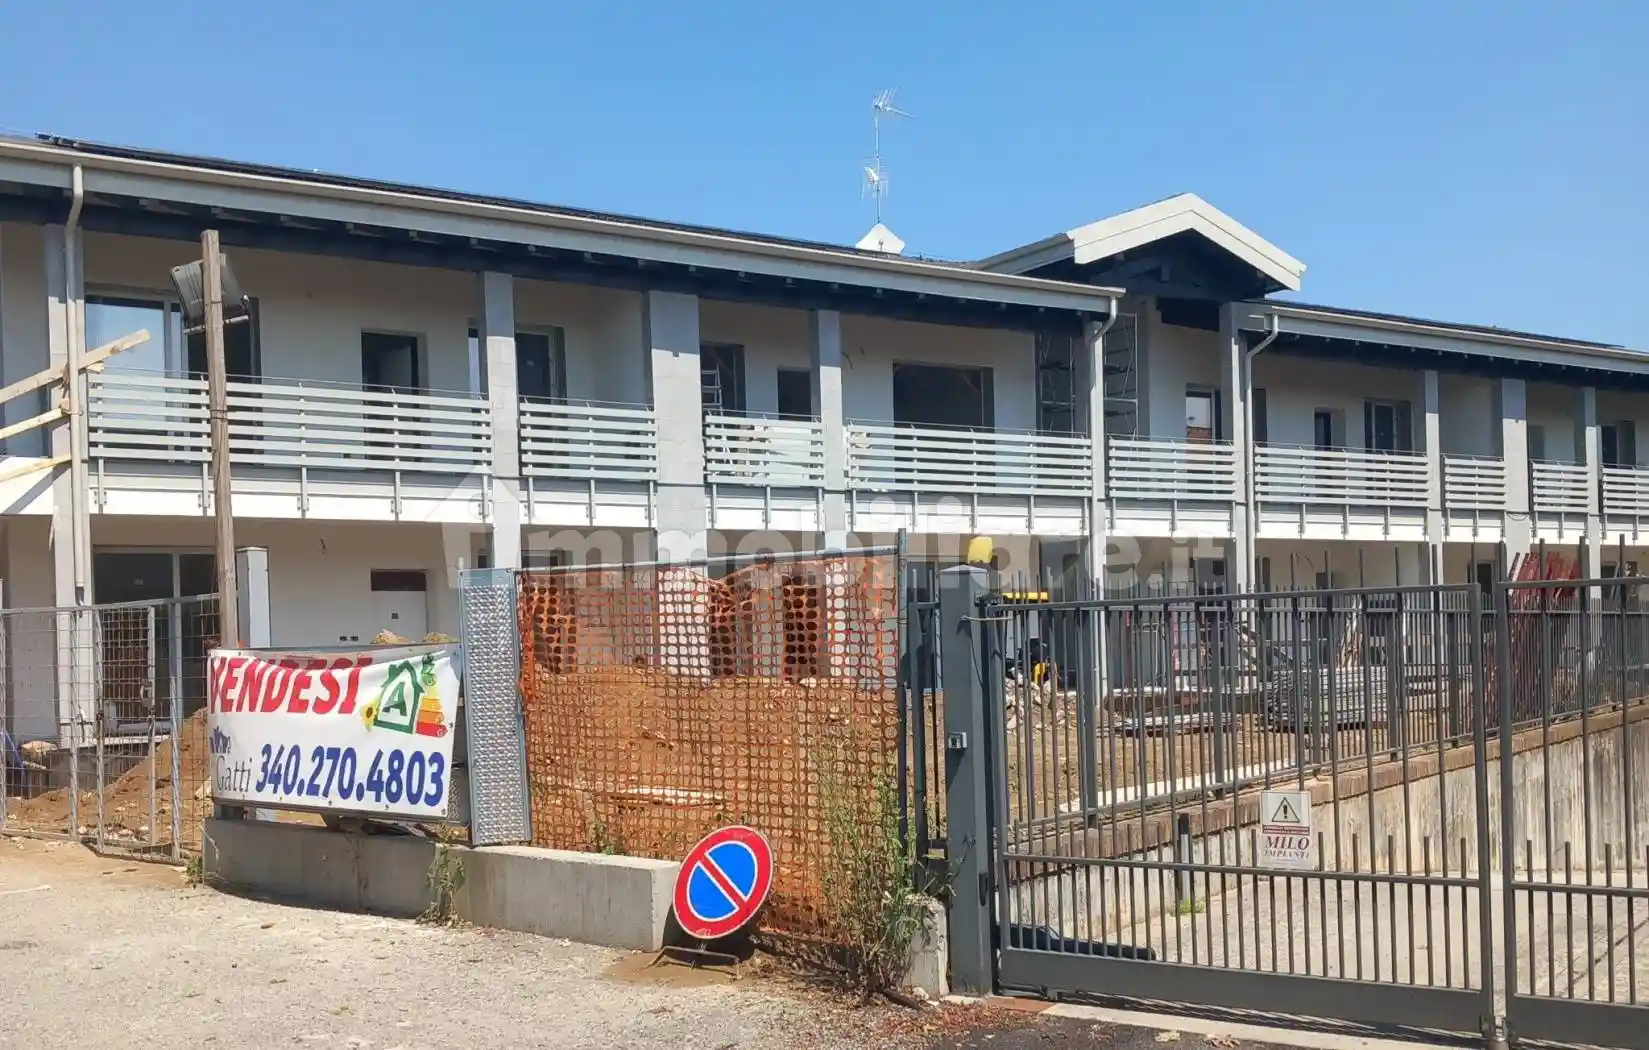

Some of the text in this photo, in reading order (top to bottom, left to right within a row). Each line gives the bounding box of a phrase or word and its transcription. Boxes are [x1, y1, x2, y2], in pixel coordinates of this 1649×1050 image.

[211, 656, 373, 714] VENDESI
[216, 743, 445, 807] Gatti 340.270.4803
[1265, 836, 1310, 850] MILO
